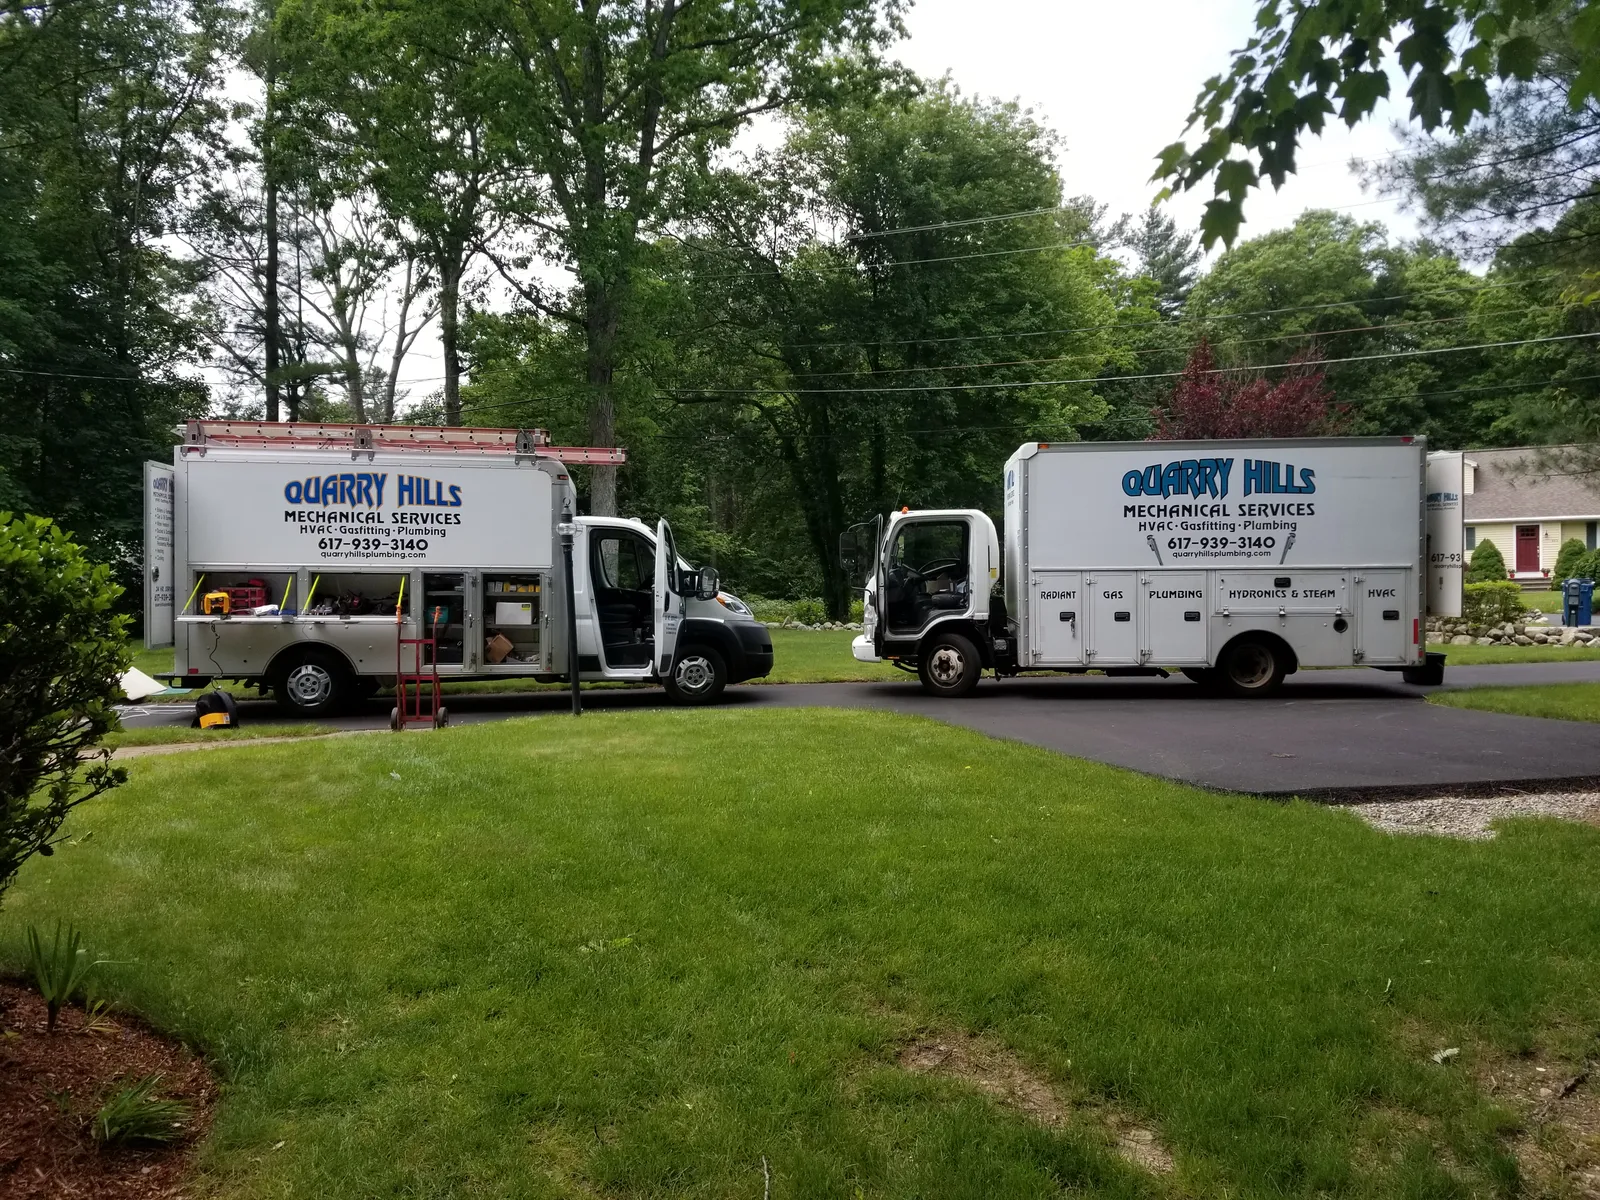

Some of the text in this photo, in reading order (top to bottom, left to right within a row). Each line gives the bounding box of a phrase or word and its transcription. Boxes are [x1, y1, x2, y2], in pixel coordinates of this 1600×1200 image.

[1122, 458, 1316, 500] QUARRY HILLS
[284, 472, 462, 510] QUARRY HILLS
[1123, 503, 1315, 518] MECHANICAL SERVICES
[284, 510, 461, 525] MECHANICAL SERVICES
[300, 525, 446, 537] HVAC Gasfitting Plumbing
[1138, 520, 1297, 532] HVAC Gasfitting Plumbing
[318, 537, 429, 551] 617-939-3140
[1167, 537, 1276, 550] 617-939-3140
[320, 551, 427, 559] quarryhillsplumbing.com
[1172, 550, 1271, 558] quarryhillsplumbing.com
[1040, 590, 1077, 600] RADIANT
[1103, 590, 1124, 600] GAS
[1149, 590, 1203, 599] PLUMBING
[1229, 589, 1336, 599] HYDRONICS & STEAM
[1368, 589, 1396, 598] HVAC
